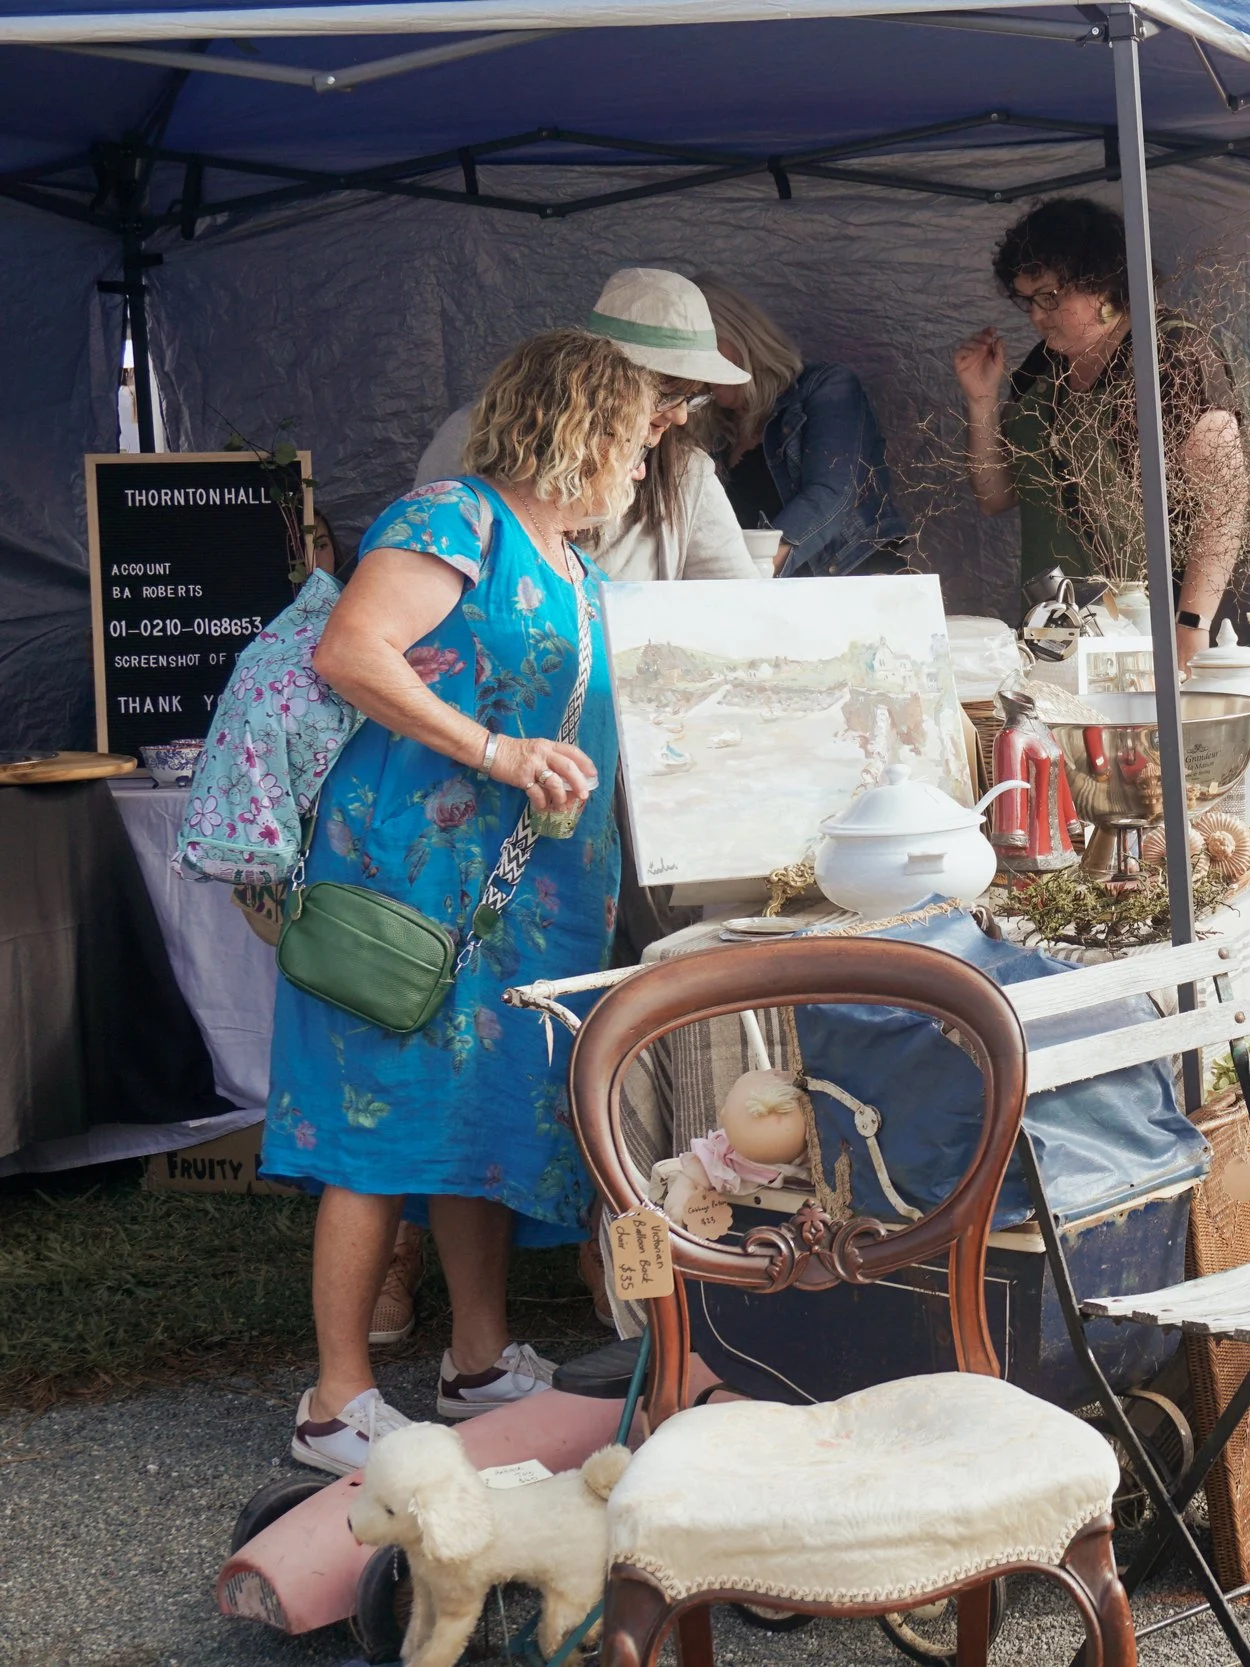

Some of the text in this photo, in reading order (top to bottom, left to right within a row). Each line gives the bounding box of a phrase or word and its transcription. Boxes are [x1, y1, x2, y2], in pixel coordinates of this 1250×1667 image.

[111, 563, 171, 576] ACCOUNT
[112, 585, 203, 599] BA ROBERTS
[114, 654, 201, 668] SCREENSHOT
[209, 653, 227, 665] OF
[117, 695, 183, 714] THANK
[166, 1152, 243, 1180] FRUITY
[632, 1219, 654, 1284] Balloon Back
[650, 1225, 664, 1269] Victorian
[619, 1263, 636, 1291] $35
